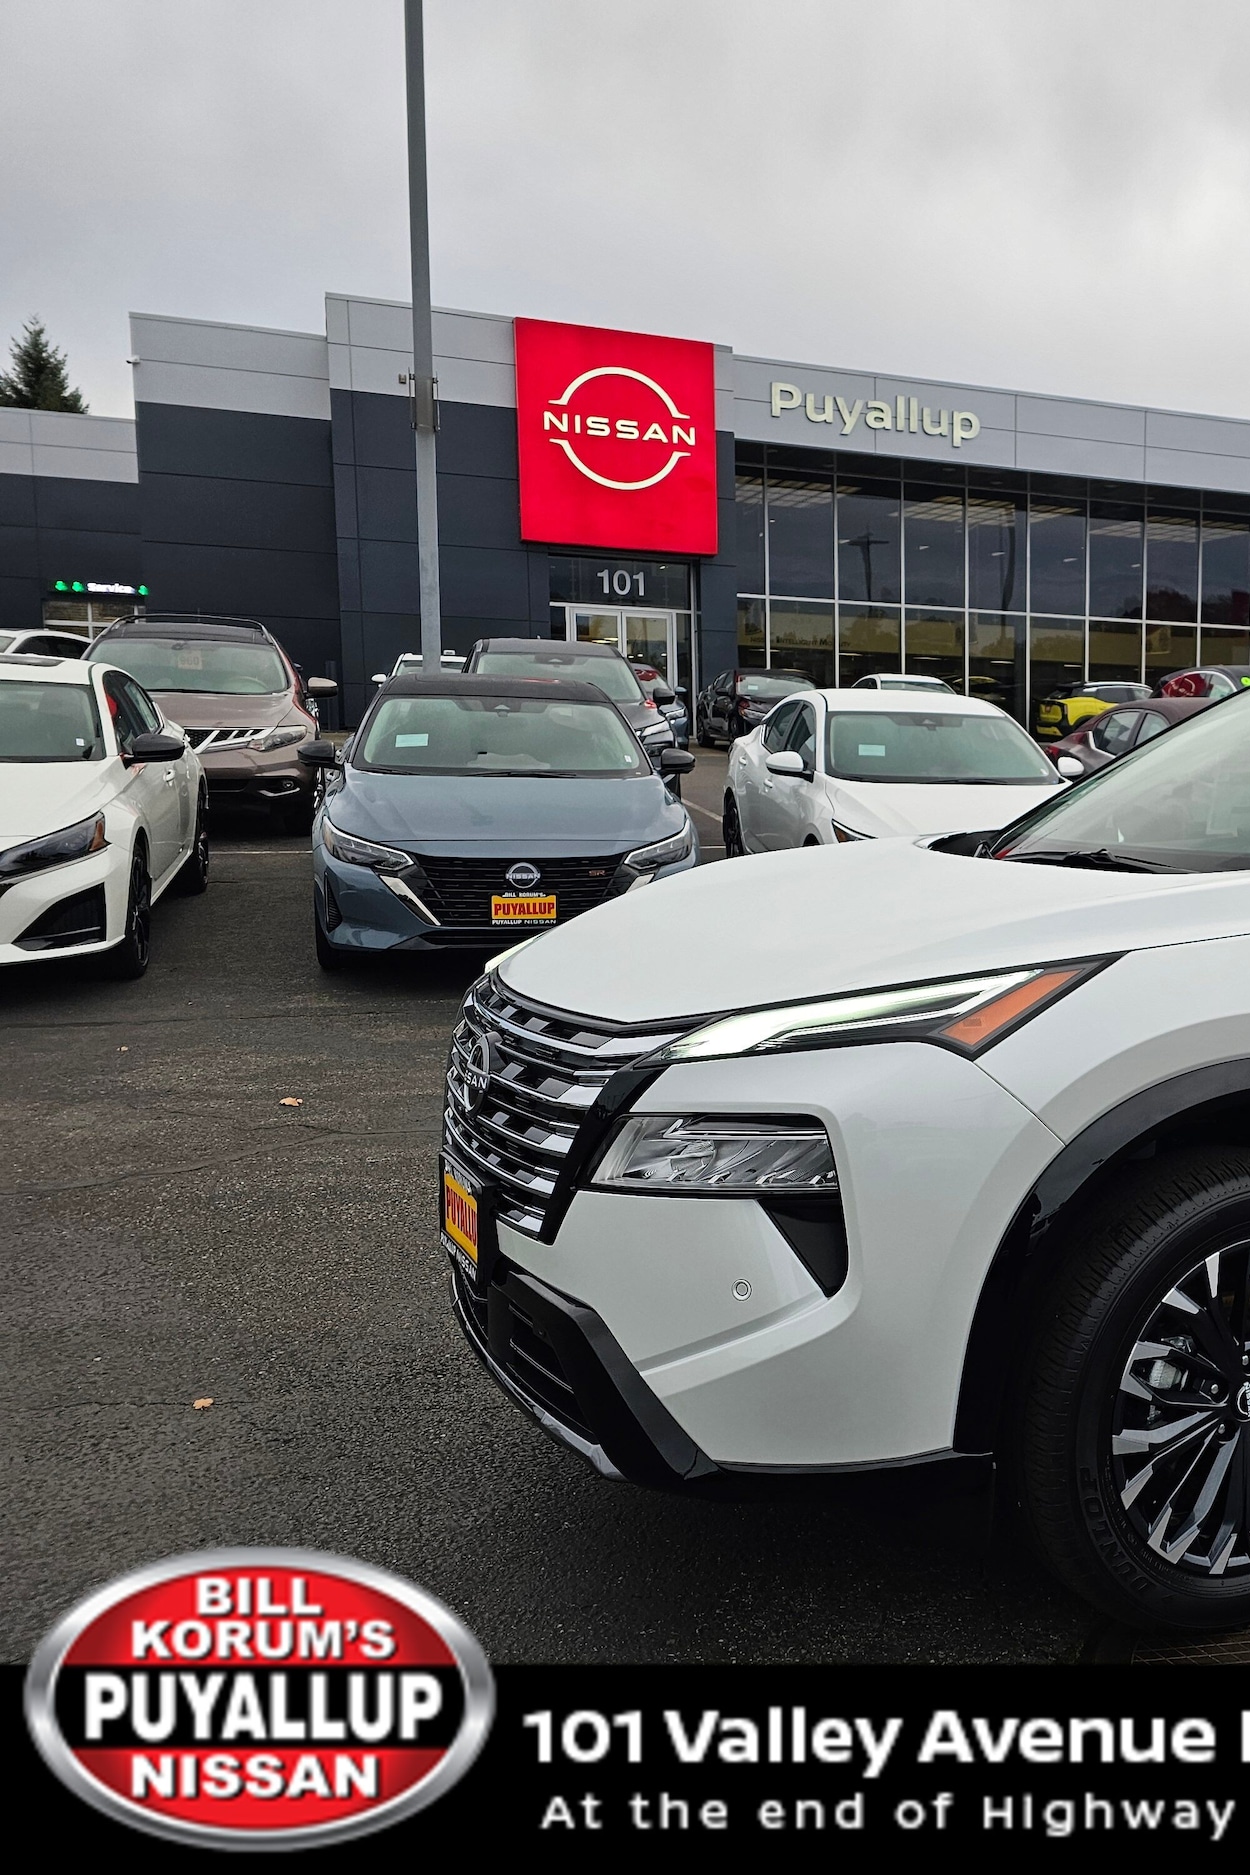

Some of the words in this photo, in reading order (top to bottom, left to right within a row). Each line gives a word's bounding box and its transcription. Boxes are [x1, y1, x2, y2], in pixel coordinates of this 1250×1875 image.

[543, 410, 697, 447] NISSAN
[770, 381, 981, 448] Puyallup
[596, 568, 646, 597] 101
[505, 872, 541, 880] NISSAN
[493, 902, 555, 916] PUYALLUP
[1078, 1464, 1159, 1593] DUNLOP
